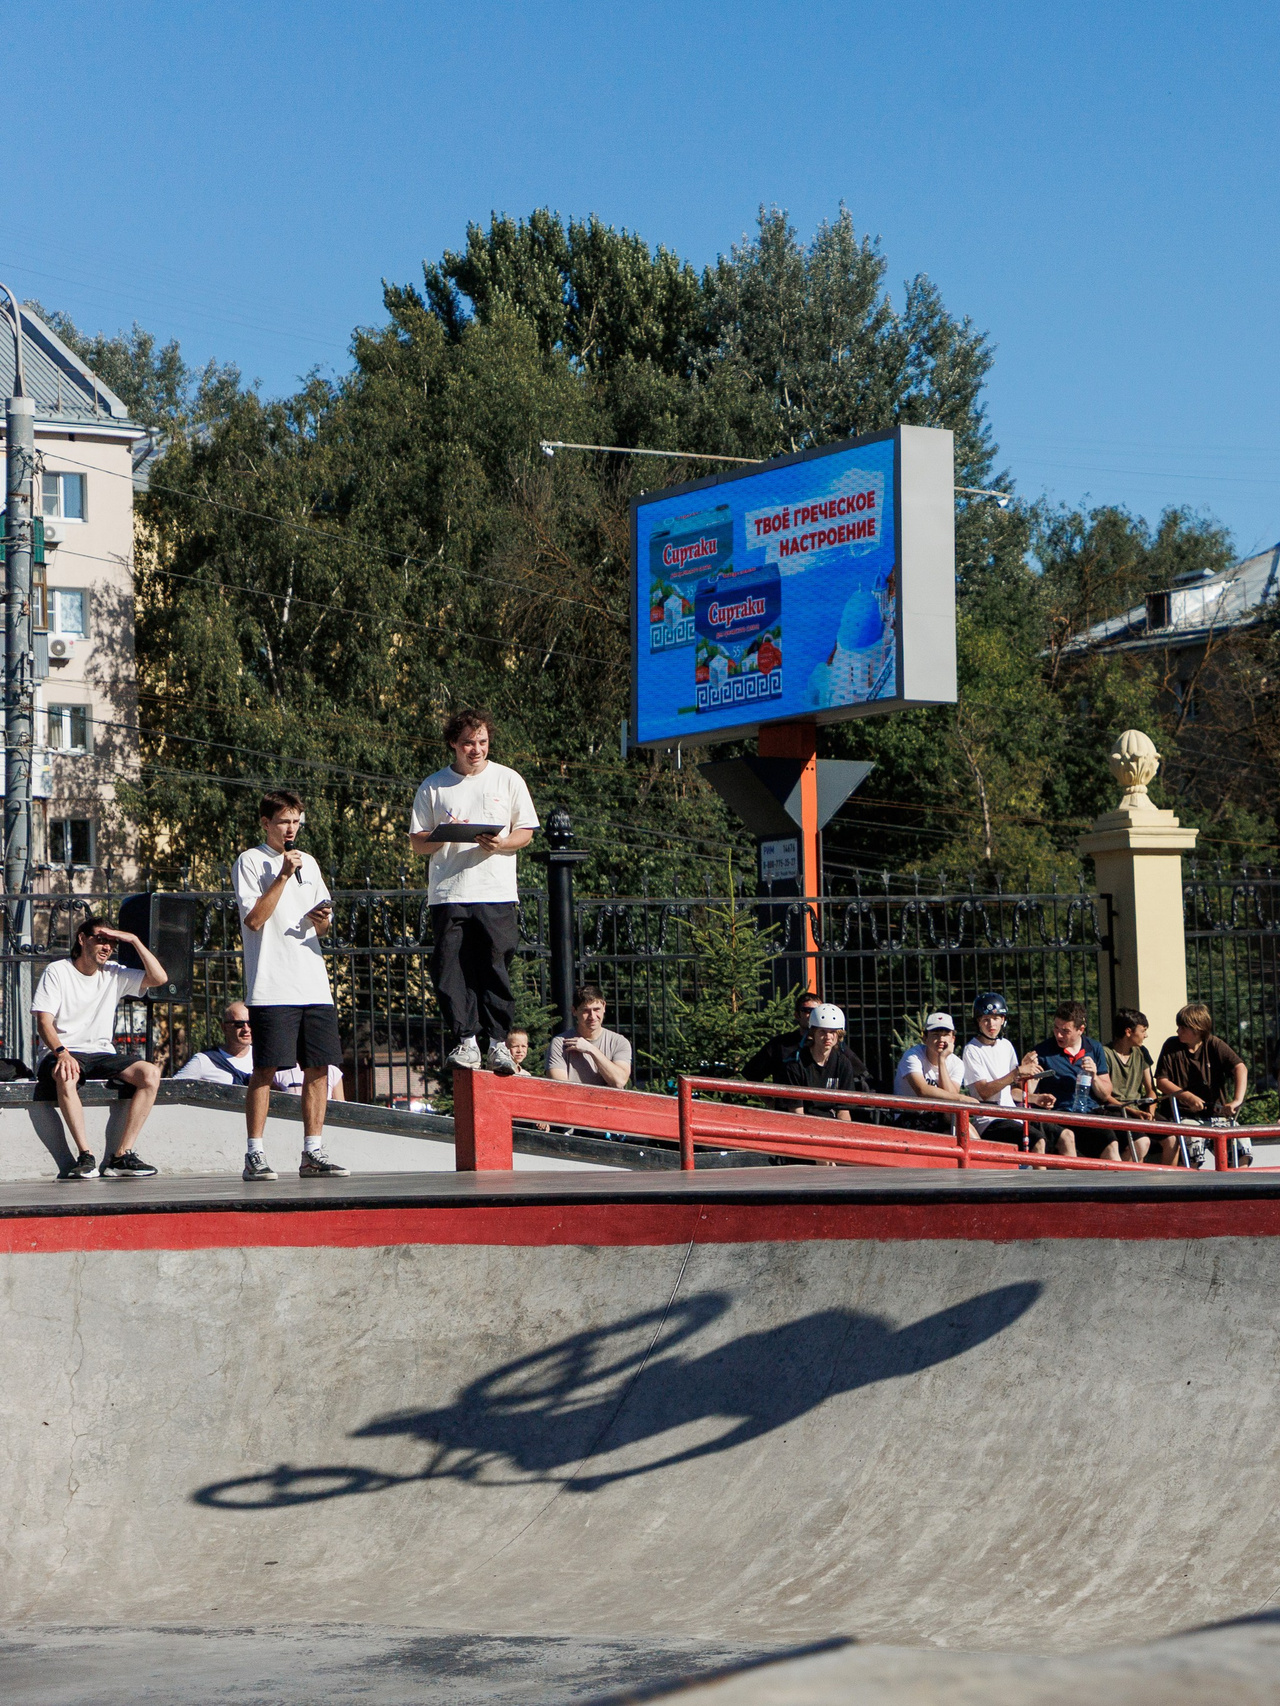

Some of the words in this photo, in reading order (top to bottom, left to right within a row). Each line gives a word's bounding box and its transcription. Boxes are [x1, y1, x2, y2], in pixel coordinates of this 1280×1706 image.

[754, 506, 790, 536] ТВОЁ
[794, 490, 876, 527] ГРЕЧЕСКОЕ
[663, 536, 718, 568] Сиртаки
[779, 517, 876, 557] НАСТРОЕНИЕ
[708, 595, 766, 628] Сиртаки
